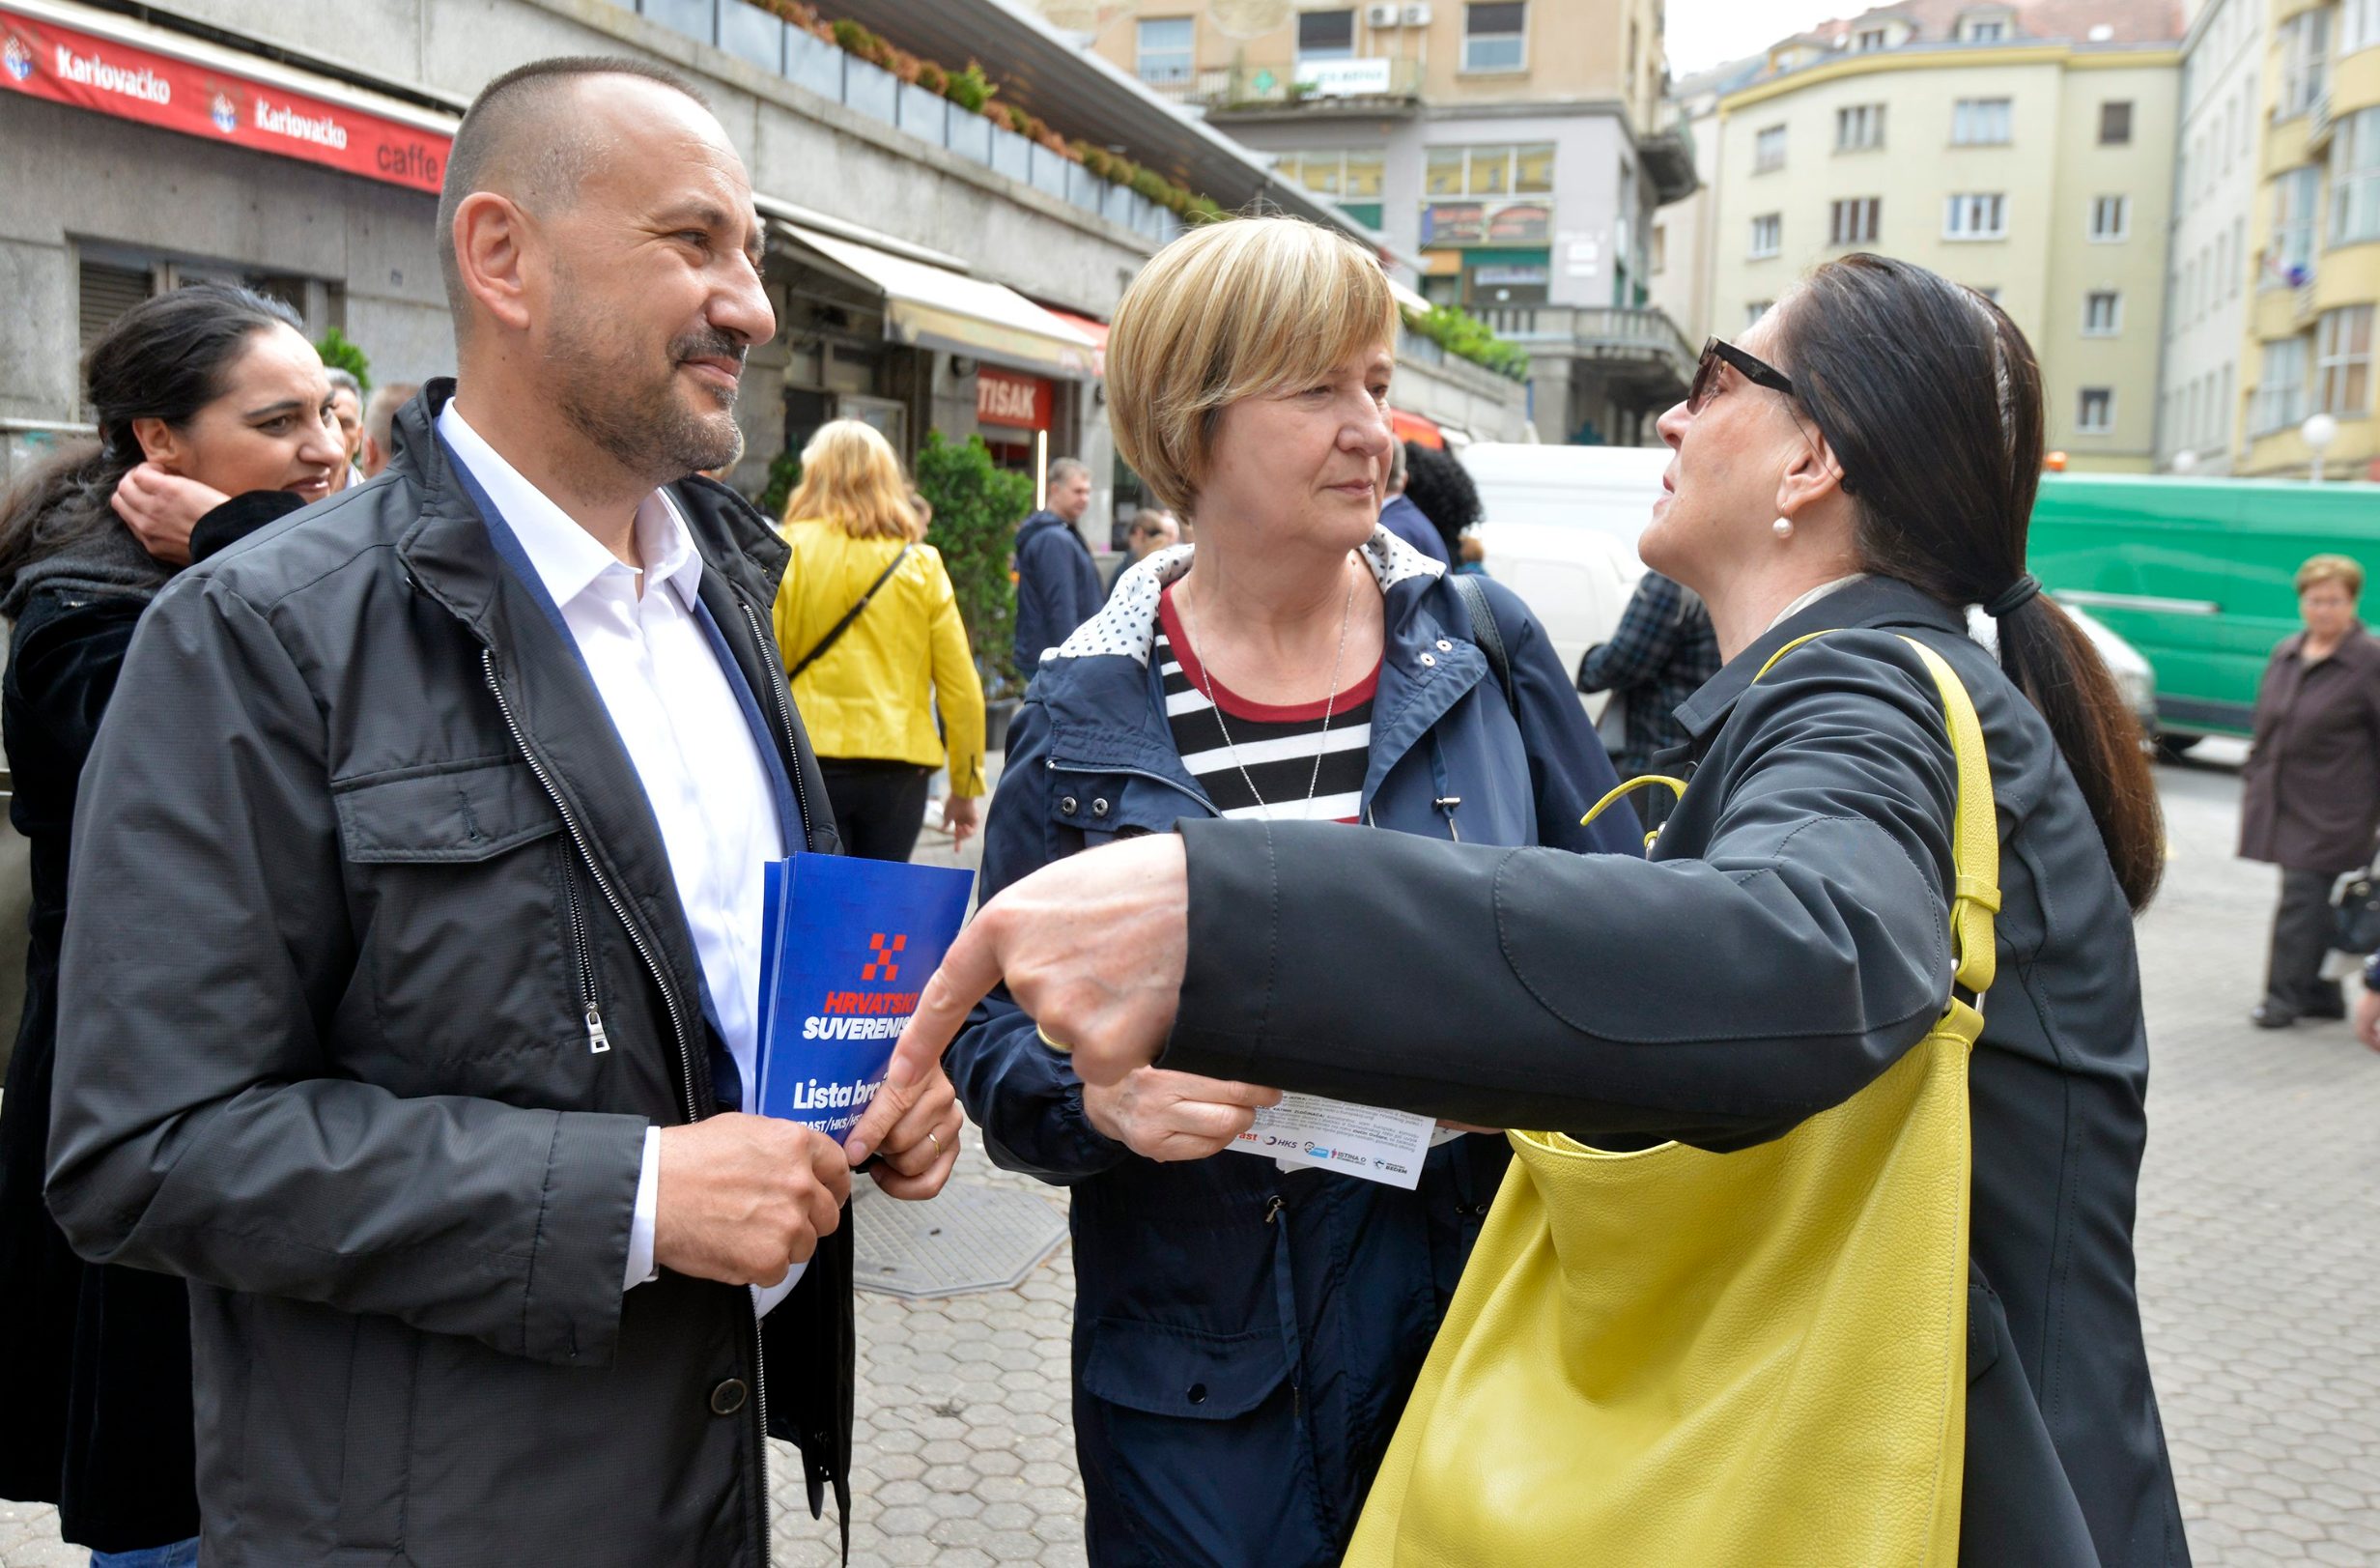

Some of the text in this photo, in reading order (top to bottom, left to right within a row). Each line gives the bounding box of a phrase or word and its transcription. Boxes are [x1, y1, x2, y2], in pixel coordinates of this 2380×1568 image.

[55, 44, 171, 105] Karlovačko
[254, 97, 348, 151] Karlovačko
[377, 144, 439, 183] caffe
[978, 377, 1036, 420] TISAK
[793, 1073, 887, 1109] Lista bro
[1277, 1139, 1298, 1149] HKS
